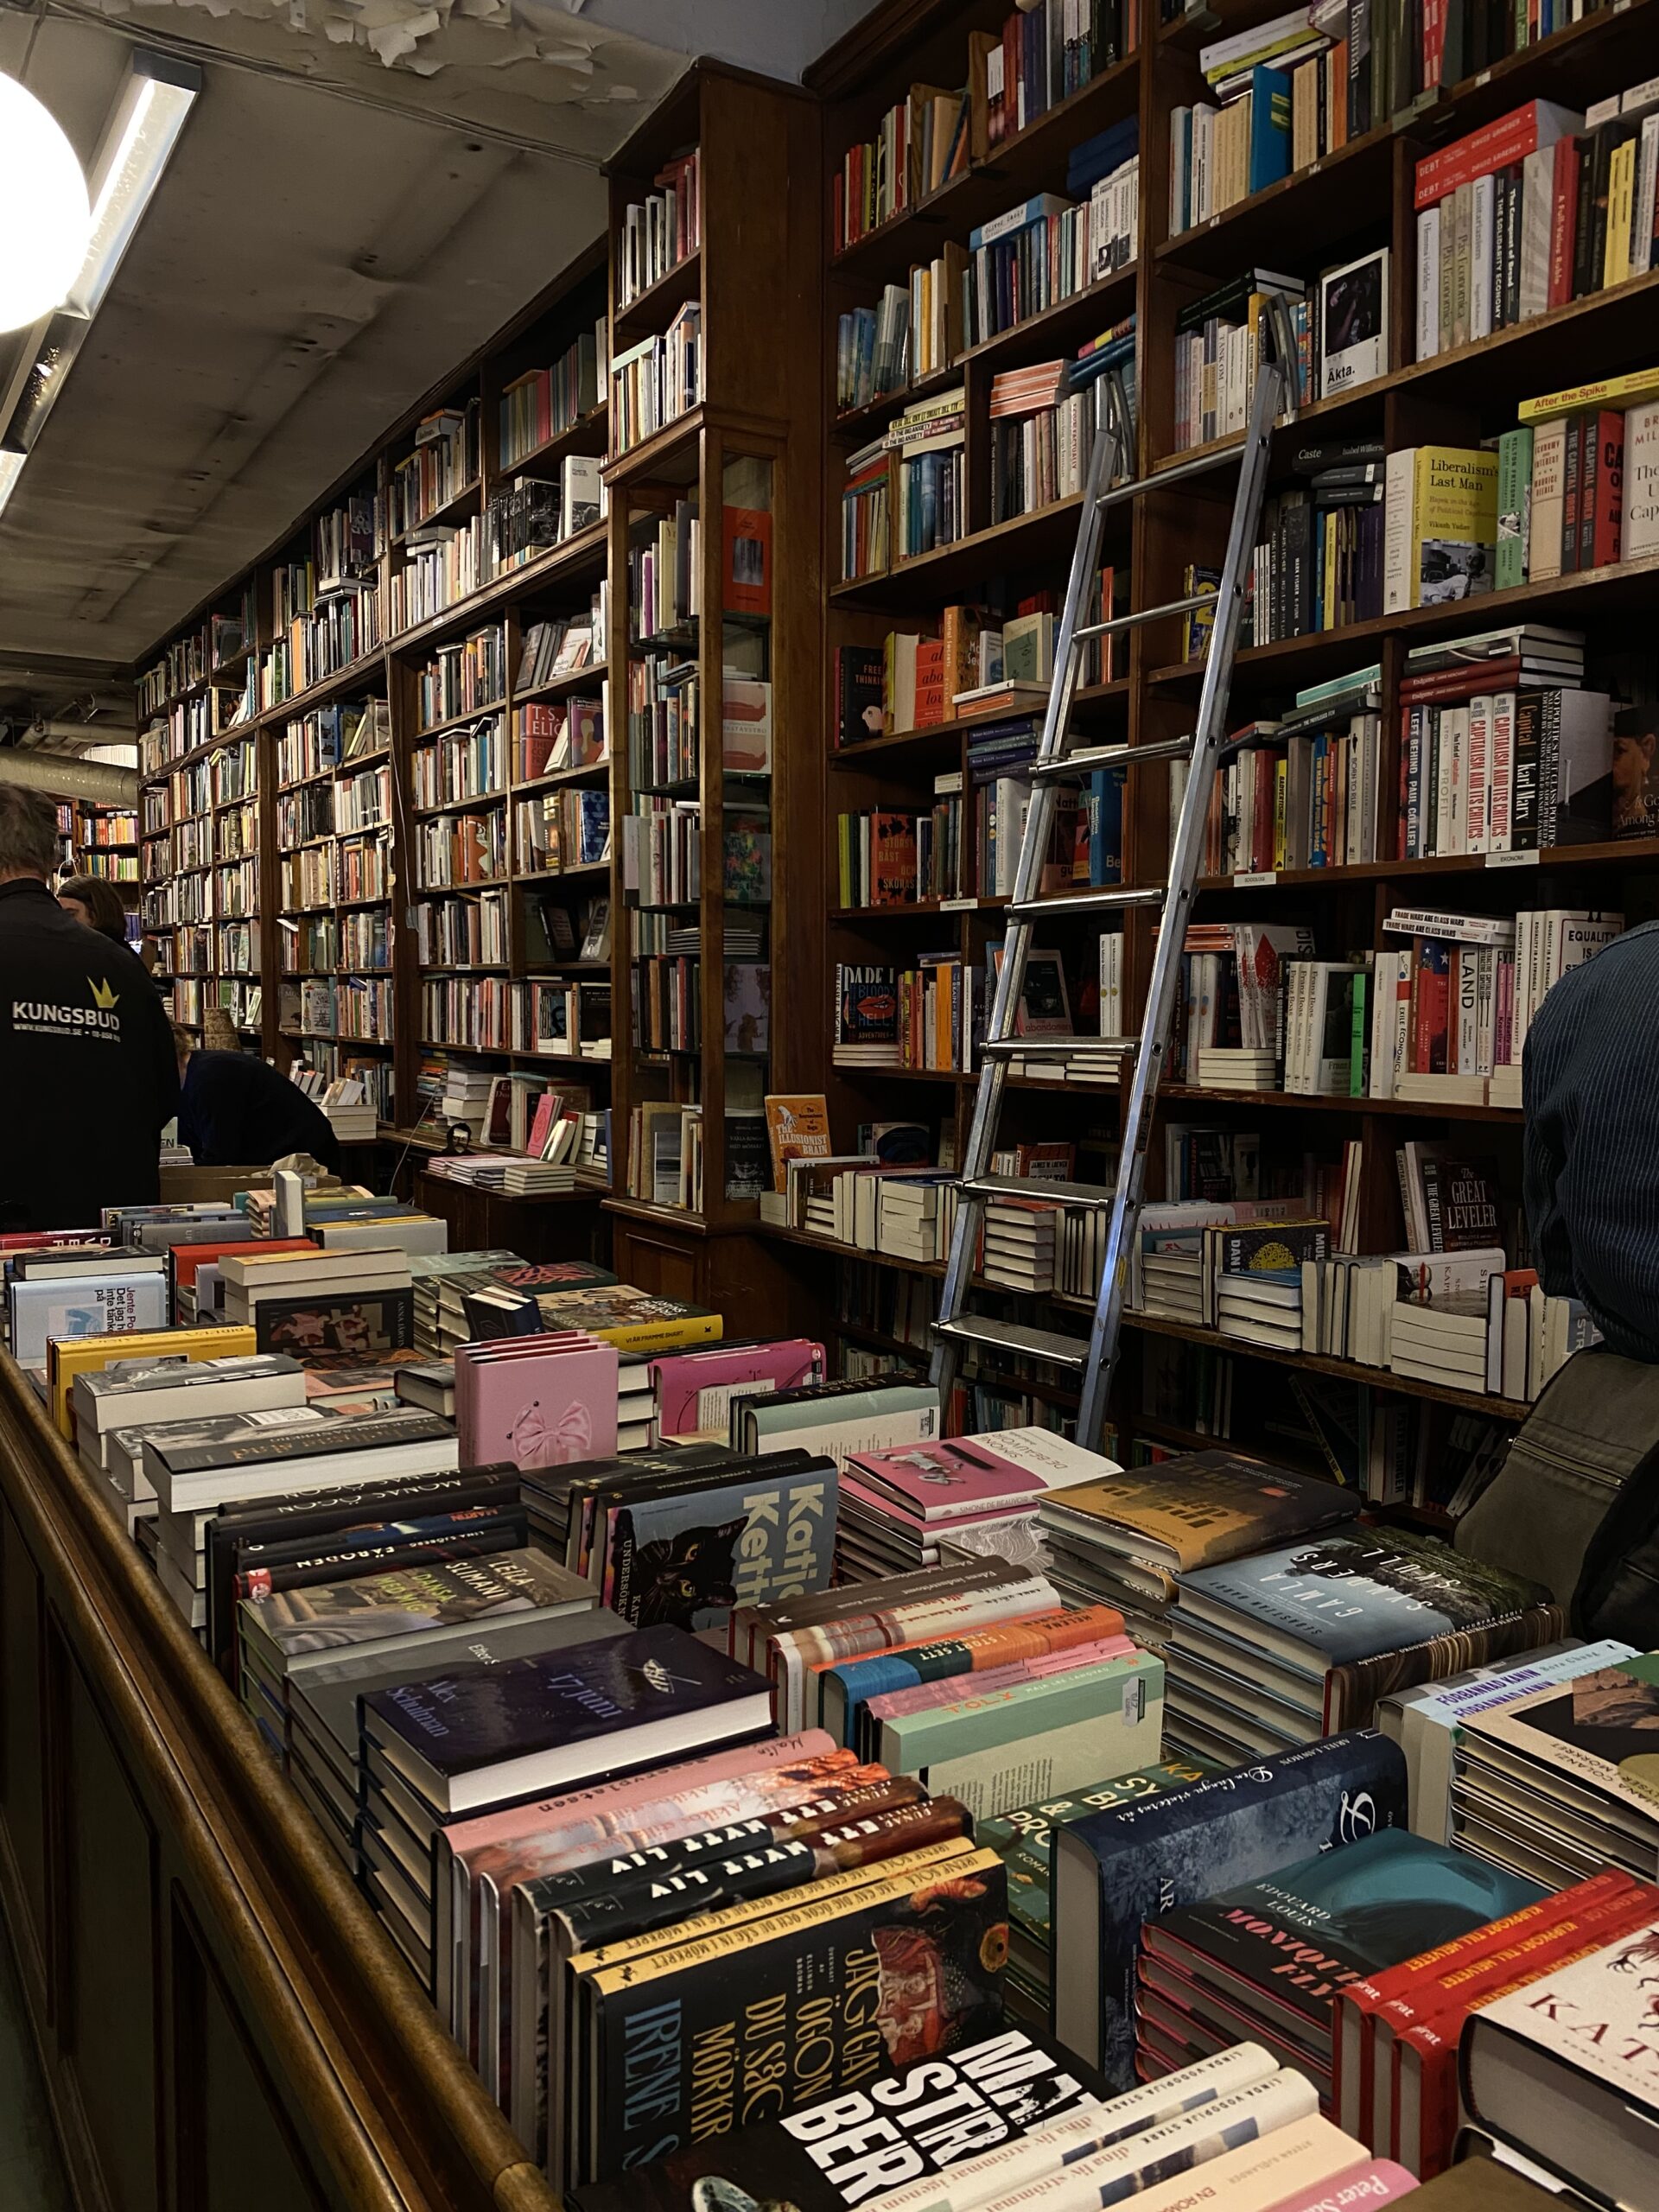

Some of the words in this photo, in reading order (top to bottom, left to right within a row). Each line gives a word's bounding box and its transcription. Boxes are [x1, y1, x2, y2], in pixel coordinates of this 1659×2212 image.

[1351, 3, 1363, 79] Bauman
[1420, 159, 1440, 175] DEBT
[1418, 182, 1440, 200] DEBT
[1535, 397, 1559, 409] After
[1561, 391, 1577, 402] the
[1579, 384, 1607, 399] Spike
[1298, 448, 1322, 460] Caste
[1586, 443, 1596, 486] CAPITAL
[1431, 458, 1498, 477] Liberalism's
[1567, 451, 1577, 492] CAPITAL
[1431, 475, 1456, 488] Last
[1459, 478, 1484, 492] Man
[1566, 493, 1575, 525] ORDER
[532, 706, 545, 721] T.
[548, 708, 560, 721] S.
[1411, 713, 1420, 735] LEFT
[1516, 705, 1537, 747] Capital
[1552, 704, 1560, 751] POLITICS
[1470, 720, 1485, 770] CAPITALISM
[1494, 717, 1510, 767] CAPITALISM
[1409, 739, 1418, 773] BEHIND
[1470, 772, 1484, 789] AND
[1493, 770, 1509, 786] AND
[1516, 763, 1536, 788] Karl
[1408, 781, 1417, 804] PAUL
[1440, 769, 1449, 817] PROFIT
[1469, 791, 1484, 804] ITS
[1493, 788, 1508, 802] ITS
[1516, 791, 1535, 820] Marx
[1408, 808, 1416, 846] COLLIER
[1469, 806, 1484, 839] CRITICS
[1492, 804, 1508, 837] CRITICS
[1548, 806, 1557, 847] POLITICS
[1386, 921, 1400, 930] TRADE
[1401, 923, 1415, 931] WARS
[1426, 926, 1440, 935] CLASS
[1441, 929, 1456, 938] WARS
[1395, 911, 1409, 919] TRADE
[1410, 912, 1424, 921] WARS
[1434, 916, 1449, 925] CLASS
[1451, 918, 1465, 926] WARS
[1568, 931, 1616, 943] EQUALITY
[1583, 948, 1592, 959] IS
[1462, 952, 1475, 1009] LAND
[12, 1001, 120, 1031] KUNGSBUD
[1395, 1028, 1406, 1073] ECONOMICS
[779, 1134, 827, 1146] ILLUSIONIST
[802, 1145, 828, 1155] BRAIN
[1427, 1182, 1439, 1197] THE
[1452, 1179, 1487, 1205] GREAT
[1427, 1198, 1440, 1223] GREAT
[1446, 1205, 1498, 1230] LEVELER
[94, 1289, 104, 1302] på
[117, 1288, 126, 1305] Det
[126, 1287, 136, 1313] Jente
[115, 1307, 125, 1322] jag
[641, 1332, 665, 1342] FRAMME
[376, 1478, 461, 1500] MONAS
[277, 1494, 362, 1514] ÖGON
[449, 1508, 499, 1522] MARTIN
[445, 1561, 510, 1599] SLIMANI
[488, 1560, 535, 1586] LEÏLA
[1293, 1552, 1433, 1611] SYNDERS
[1362, 1548, 1461, 1590] SKULL
[373, 1576, 404, 1597] MED
[400, 1591, 430, 1612] MIG
[412, 1573, 456, 1603] DANSA
[1209, 1580, 1249, 1600] BARRY
[1259, 1572, 1363, 1618] GAMLA
[1043, 1614, 1092, 1630] HELENA
[1252, 1600, 1323, 1636] SEBASTIAN
[919, 1646, 952, 1661] SETT
[426, 1680, 459, 1704] Alex
[547, 1674, 585, 1689] 17
[1436, 1678, 1507, 1707] FÖRBANNAD
[1504, 1668, 1541, 1683] KANIN
[386, 1686, 450, 1738] Schulman
[561, 1688, 622, 1719] juni
[944, 1691, 1018, 1714] TOLK
[758, 1737, 804, 1758] Malin
[1315, 1738, 1351, 1755] ARIEL
[1551, 1742, 1614, 1774] MÖRKRET
[1233, 1765, 1274, 1783] Den
[1554, 1752, 1614, 1783] COLANZI
[1193, 1777, 1236, 1795] långa
[779, 1800, 838, 1825] ETT
[1039, 1799, 1074, 1818] &
[1137, 1790, 1192, 1815] vinterns
[1115, 1811, 1135, 1823] år
[682, 1818, 768, 1852] NYTT
[821, 1819, 880, 1847] ETT
[611, 1847, 670, 1876] LIV
[721, 1840, 810, 1877] NYTT
[912, 1841, 950, 1862] IRENE
[847, 1867, 868, 1884] JAG
[941, 1856, 979, 1878] IRENE
[651, 1869, 709, 1900] LIV
[877, 1881, 898, 1899] JAG
[772, 1889, 805, 1908] ÖGON
[834, 1897, 854, 1913] DIG
[852, 1889, 876, 1908] GAV
[777, 1913, 802, 1931] OCH
[801, 1904, 834, 1926] ÖGON
[1267, 1900, 1317, 1928] LOUIS
[1487, 1906, 1545, 1936] KLIPPKORT
[625, 1925, 683, 1951] MÖRKRET
[719, 1935, 735, 1948] IN
[735, 1927, 760, 1945] SÅG
[760, 1922, 779, 1936] DU
[1463, 1930, 1489, 1947] TILL
[1520, 1921, 1579, 1954] KLIPPKORT
[652, 1942, 711, 1969] MÖRKRET
[1405, 1941, 1465, 1972] HELVETET
[1497, 1946, 1522, 1963] TILL
[843, 1948, 883, 2025] JAG
[1438, 1958, 1497, 1990] HELVETET
[743, 1993, 787, 2043] DU
[793, 1993, 842, 2103] ÖGON
[1207, 2050, 1243, 2069] LINDA
[623, 1998, 682, 2133] IRENE
[1144, 2065, 1205, 2095] VODOPIJA
[1246, 2077, 1283, 2098] LINDA
[1103, 2089, 1141, 2113] STARK
[1183, 2094, 1243, 2124] VODOPIJA
[1054, 2115, 1093, 2134] dina
[1141, 2120, 1181, 2145] STARK
[779, 2088, 925, 2206] BER
[1035, 2131, 1056, 2146] liv
[950, 2142, 1032, 2182] strömmar
[1091, 2145, 1131, 2167] dina
[1071, 2161, 1094, 2178] liv
[881, 2177, 950, 2210] igenom
[1195, 2186, 1217, 2202] EN
[1336, 2174, 1391, 2207] Peter
